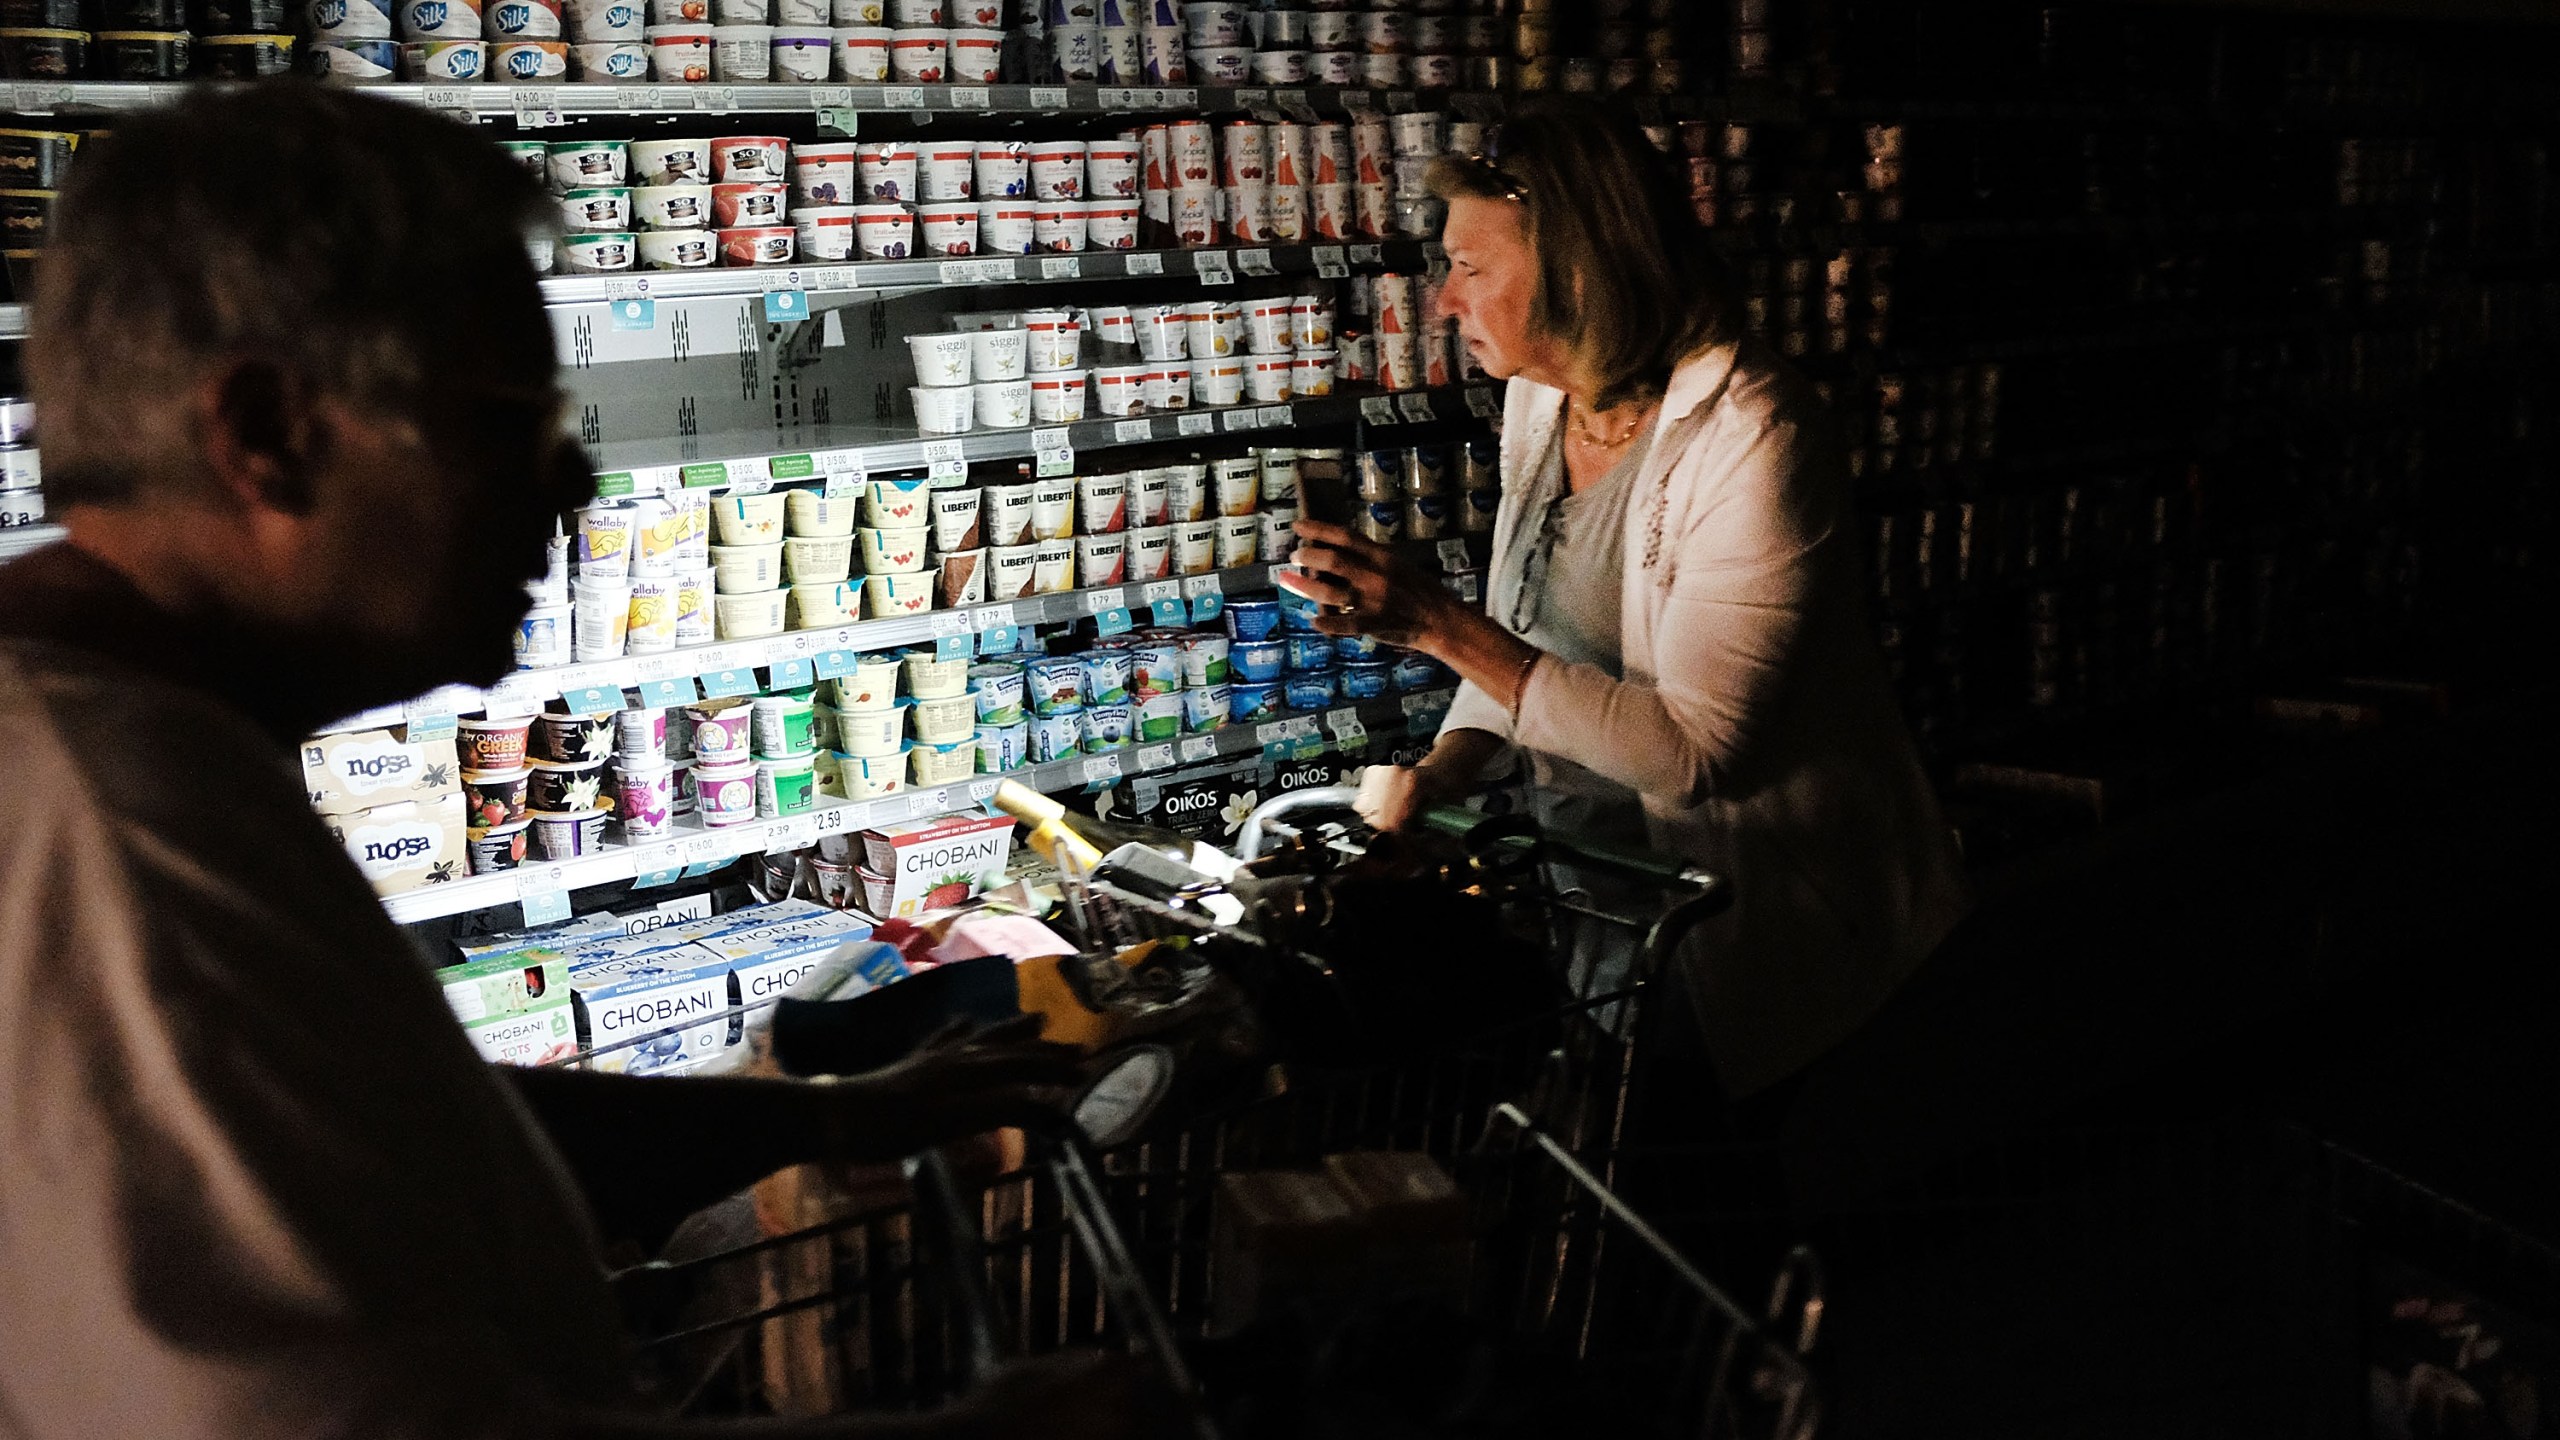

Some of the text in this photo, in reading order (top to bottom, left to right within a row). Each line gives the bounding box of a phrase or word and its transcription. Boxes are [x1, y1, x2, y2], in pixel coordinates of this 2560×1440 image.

[315, 0, 345, 27] Silk
[414, 2, 447, 29] Silk
[496, 6, 529, 31] Silk
[607, 7, 631, 27] Silk
[449, 51, 478, 77] Silk
[509, 53, 542, 79] Silk
[607, 56, 632, 76] Silk
[1006, 495, 1034, 507] LIBERT
[587, 516, 628, 528] wallaby
[632, 583, 665, 595] allaby
[939, 651, 970, 660] ORGANIC
[822, 666, 856, 677] ORGANIC
[715, 685, 750, 695] ORGANIC
[776, 677, 811, 688] ORGANIC
[579, 702, 617, 712] ORGANIC
[1094, 708, 1128, 720] Stonyfield
[477, 732, 525, 743] ORGANIC
[477, 740, 523, 753] GREEK
[347, 754, 412, 777] noosa
[1281, 766, 1330, 790] OIKOS
[1165, 792, 1217, 815] OIKOS
[814, 810, 841, 831] $2.59
[1167, 809, 1218, 825] TRIPLE ZERO
[919, 821, 991, 841] STRAWBERRY ON THE BOTTOM
[364, 836, 431, 862] noosa
[906, 838, 998, 873] CHOBANI
[530, 910, 569, 922] ORGANIC
[564, 937, 591, 946] BOTTOM
[721, 919, 829, 945] CHOBANI
[764, 948, 796, 961] BLUEBERRY
[816, 938, 840, 949] BOTTOM
[572, 951, 686, 981] CHOBANI
[616, 972, 696, 994] BLUEBERRY ON THE BOTTOM
[602, 990, 713, 1030] CHOBANI
[483, 1020, 545, 1045] CHOBANI
[500, 1043, 531, 1059] TOTS
